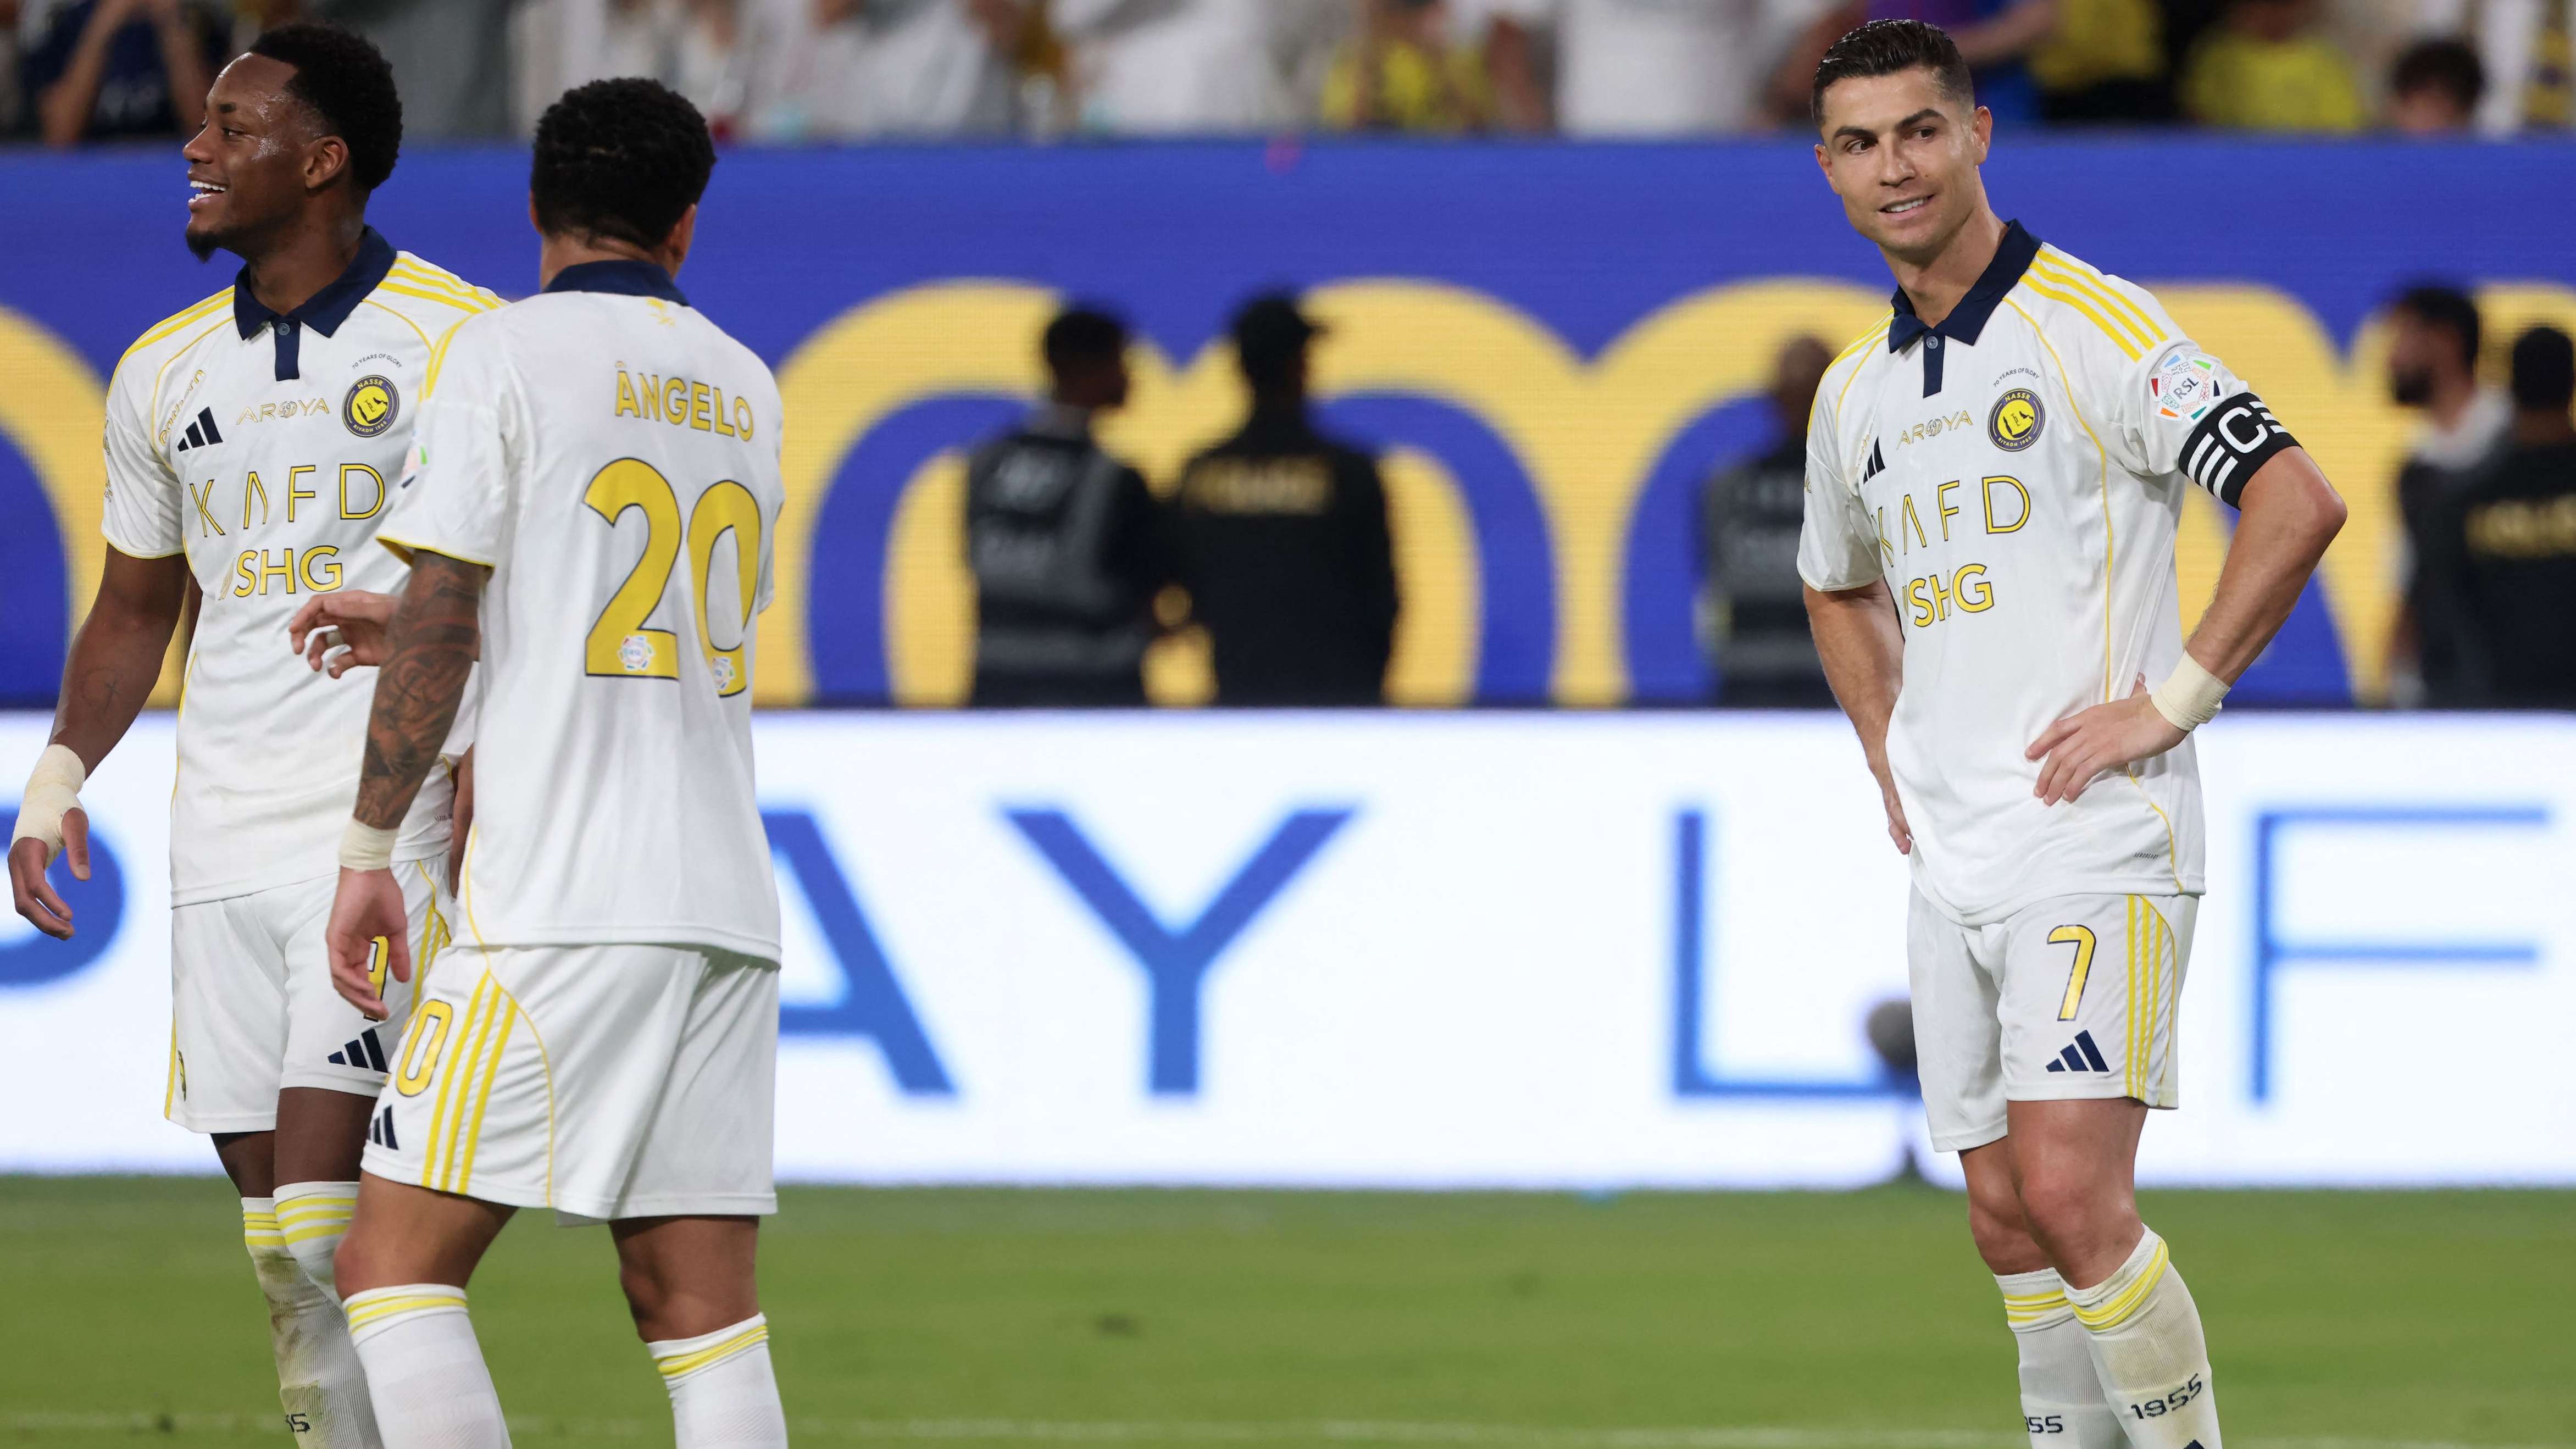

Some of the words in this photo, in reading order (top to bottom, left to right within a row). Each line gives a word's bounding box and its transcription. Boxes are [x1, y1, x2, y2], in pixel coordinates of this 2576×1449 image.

[359, 354, 377, 364] YEARS
[386, 355, 402, 368] GLORY
[1999, 369, 2017, 380] YEARS
[2025, 368, 2040, 379] GLORY
[357, 379, 384, 389] NASSR
[2173, 377, 2200, 399] RSL
[2005, 392, 2031, 402] NASSR
[353, 424, 374, 432] RIYADH
[2218, 407, 2268, 453] C
[1998, 437, 2018, 447] RIYADH
[582, 457, 762, 697] 20
[2047, 924, 2097, 1021] 7
[387, 999, 453, 1097] 0
[2131, 1373, 2202, 1419] 1955
